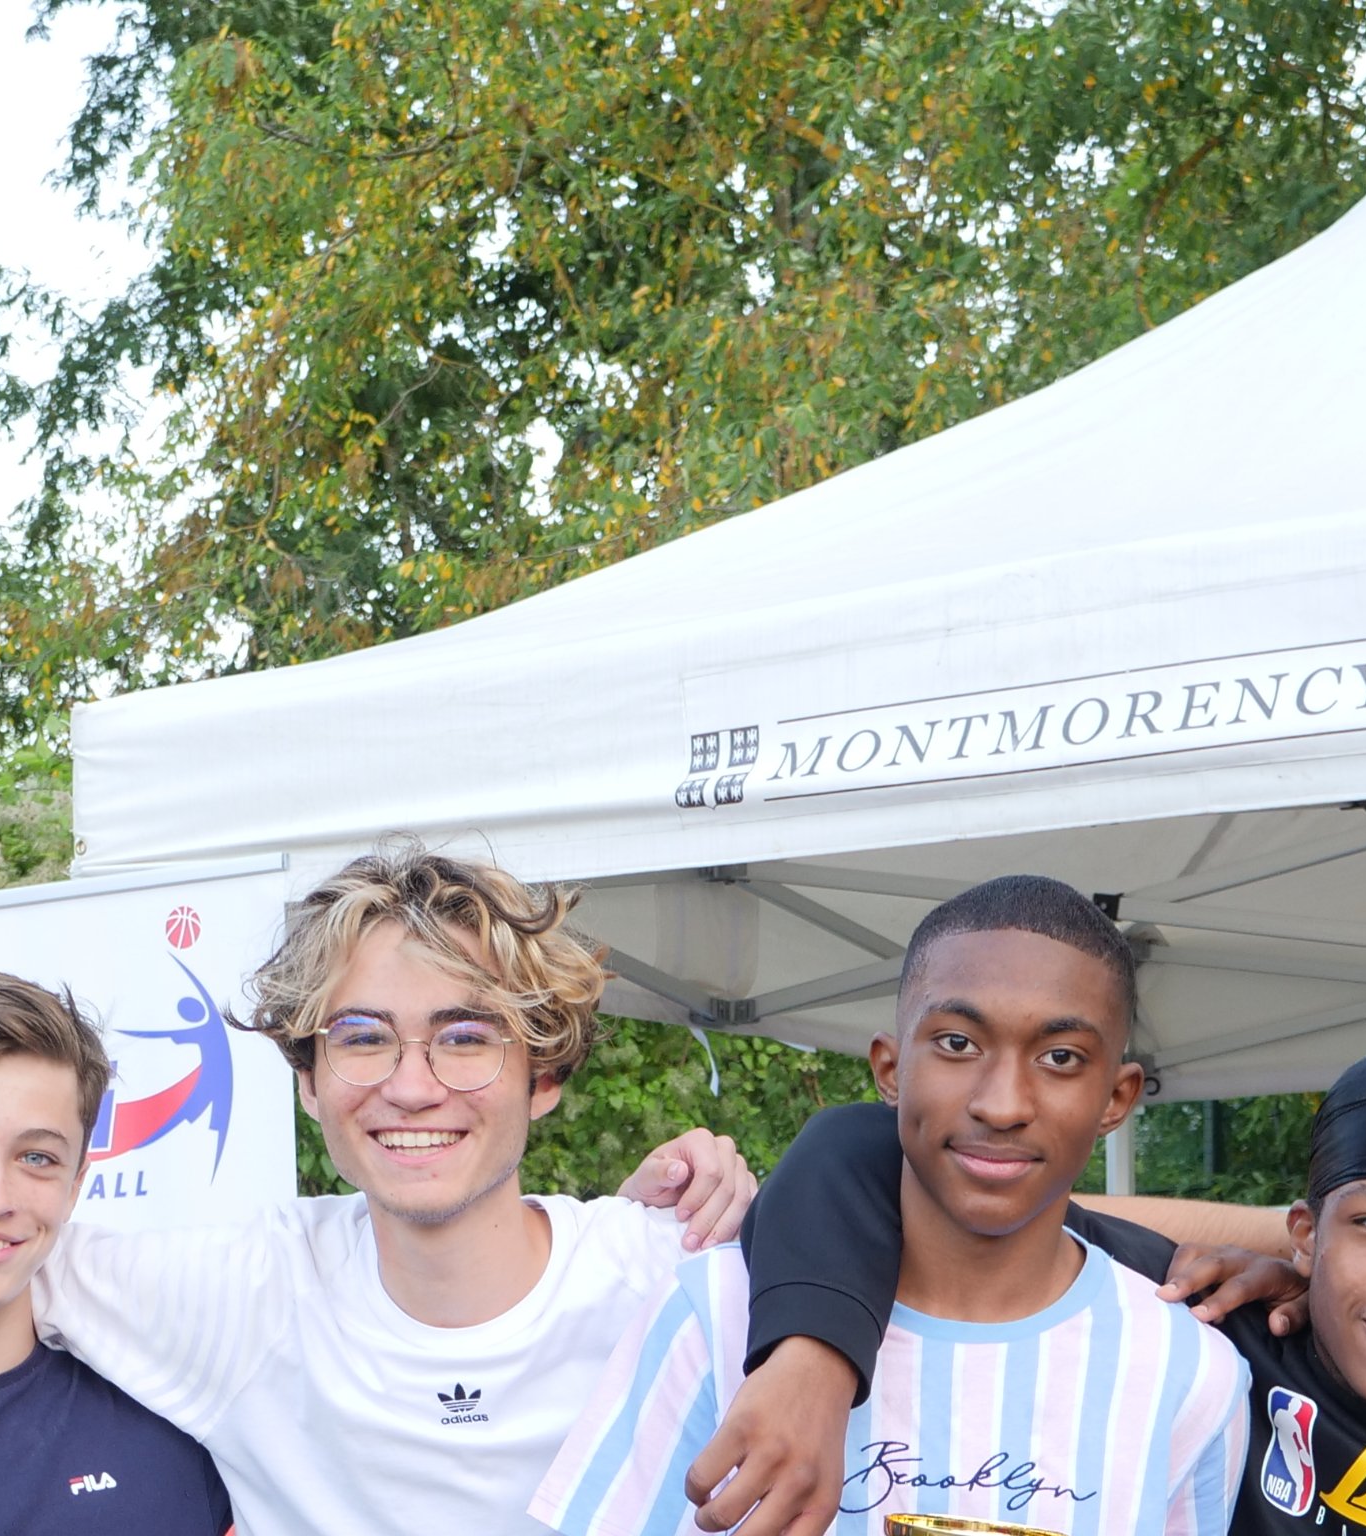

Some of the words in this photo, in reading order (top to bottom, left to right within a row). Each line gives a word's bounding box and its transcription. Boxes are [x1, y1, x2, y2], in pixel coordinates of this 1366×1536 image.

[88, 1171, 147, 1199] ALL
[441, 1413, 489, 1425] adidas
[69, 1471, 117, 1495] FILA
[838, 1440, 1098, 1514] Brooklyn
[1266, 1473, 1293, 1503] NBA
